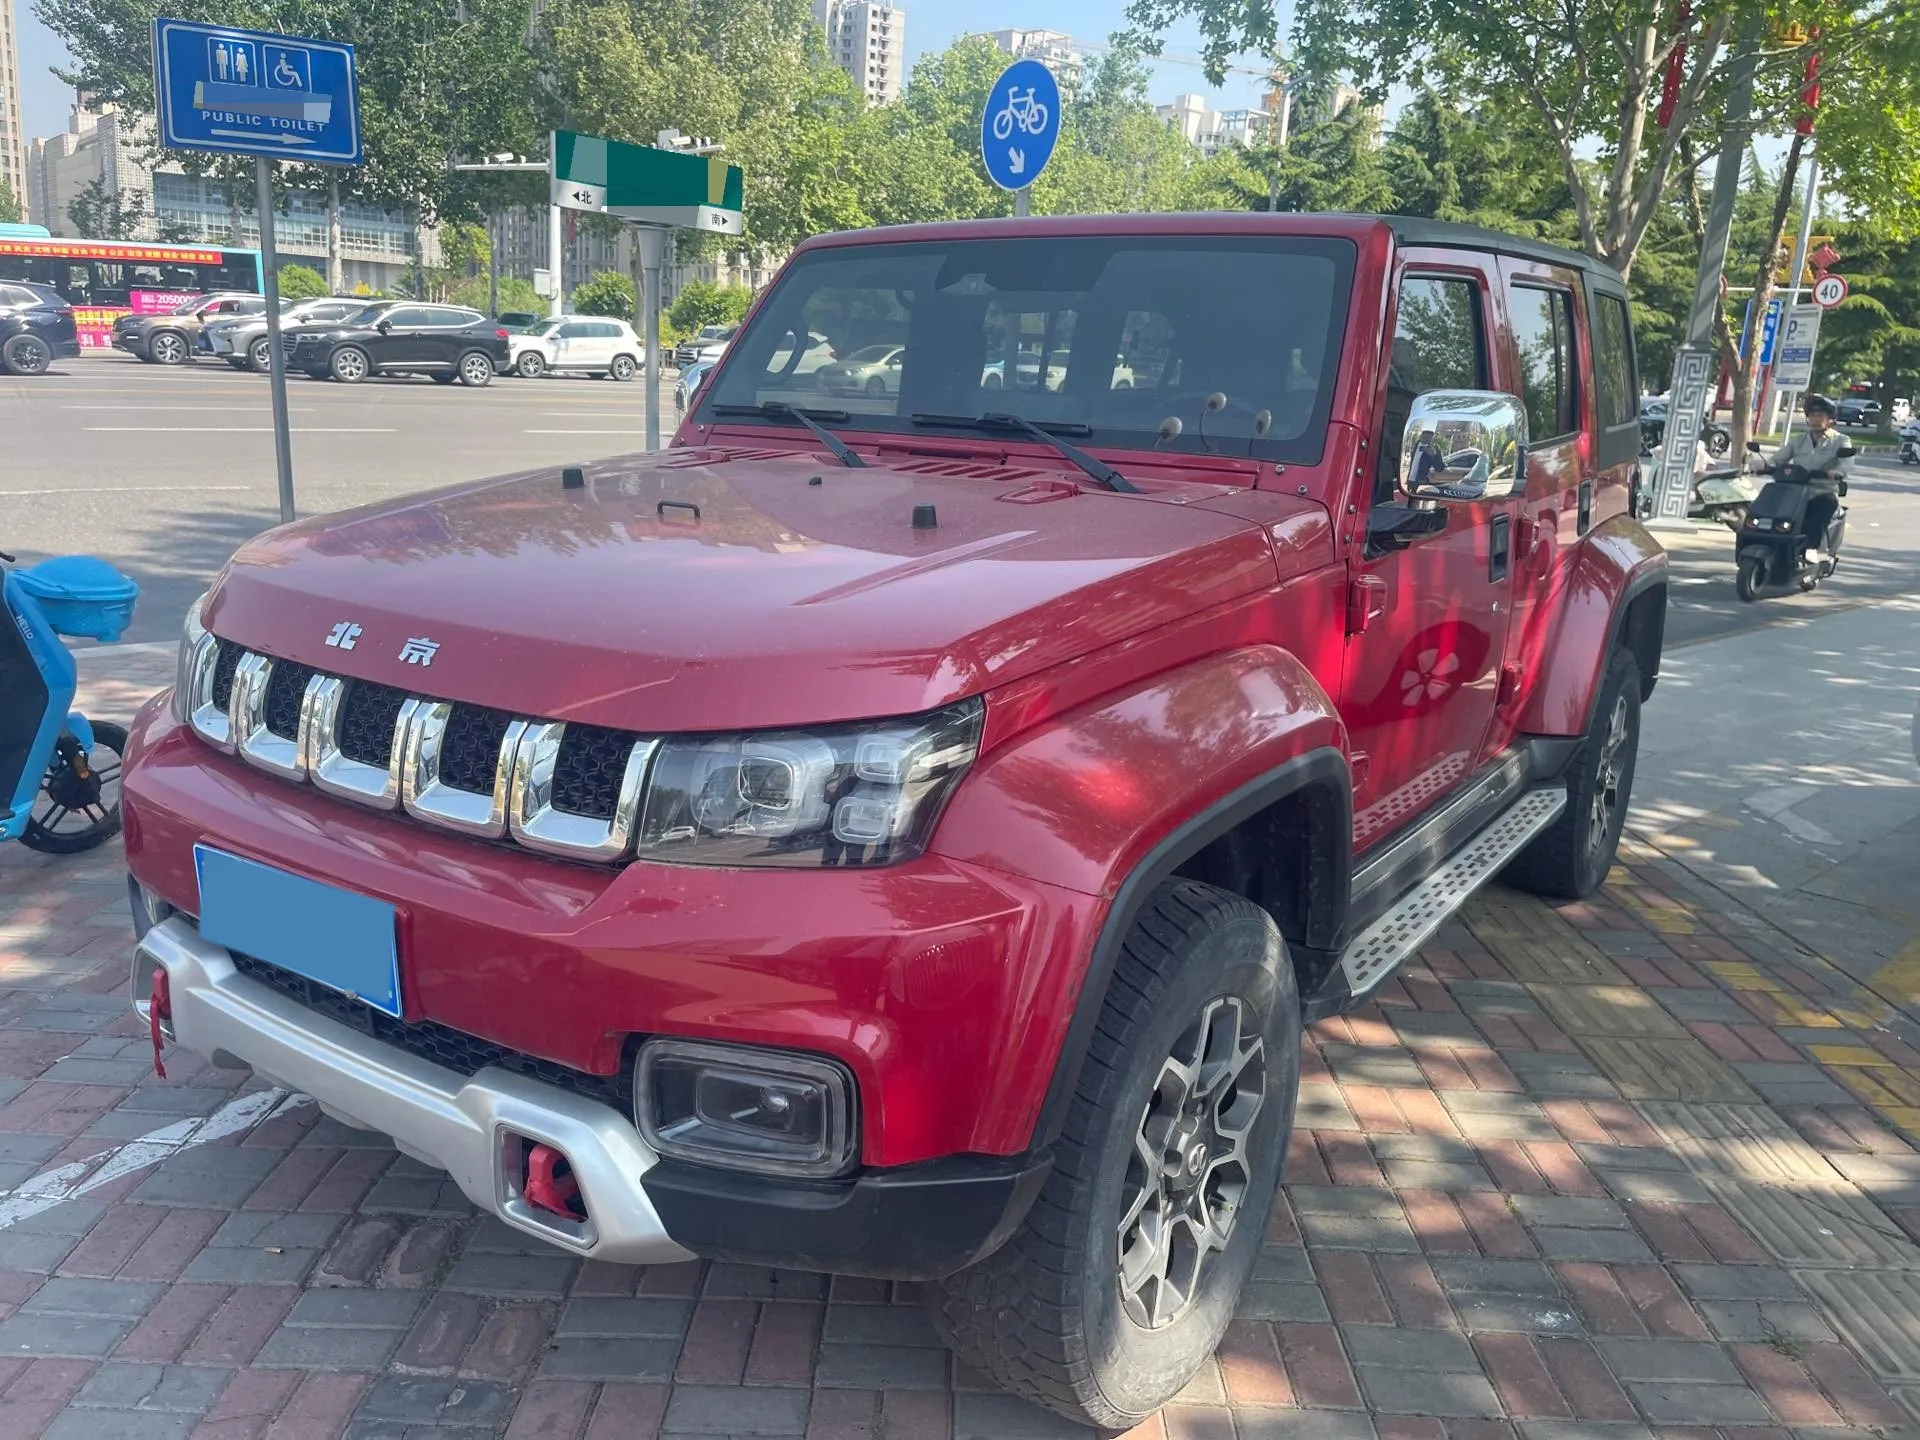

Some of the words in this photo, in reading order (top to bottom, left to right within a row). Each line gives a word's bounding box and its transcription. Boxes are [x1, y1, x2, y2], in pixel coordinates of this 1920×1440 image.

[202, 111, 262, 126] PUBLIC
[269, 117, 325, 132] TOILET
[581, 190, 592, 205] 北
[711, 213, 720, 226] 南
[1821, 284, 1838, 299] 40
[16, 615, 34, 640] HELLO
[325, 621, 440, 667] 北京
